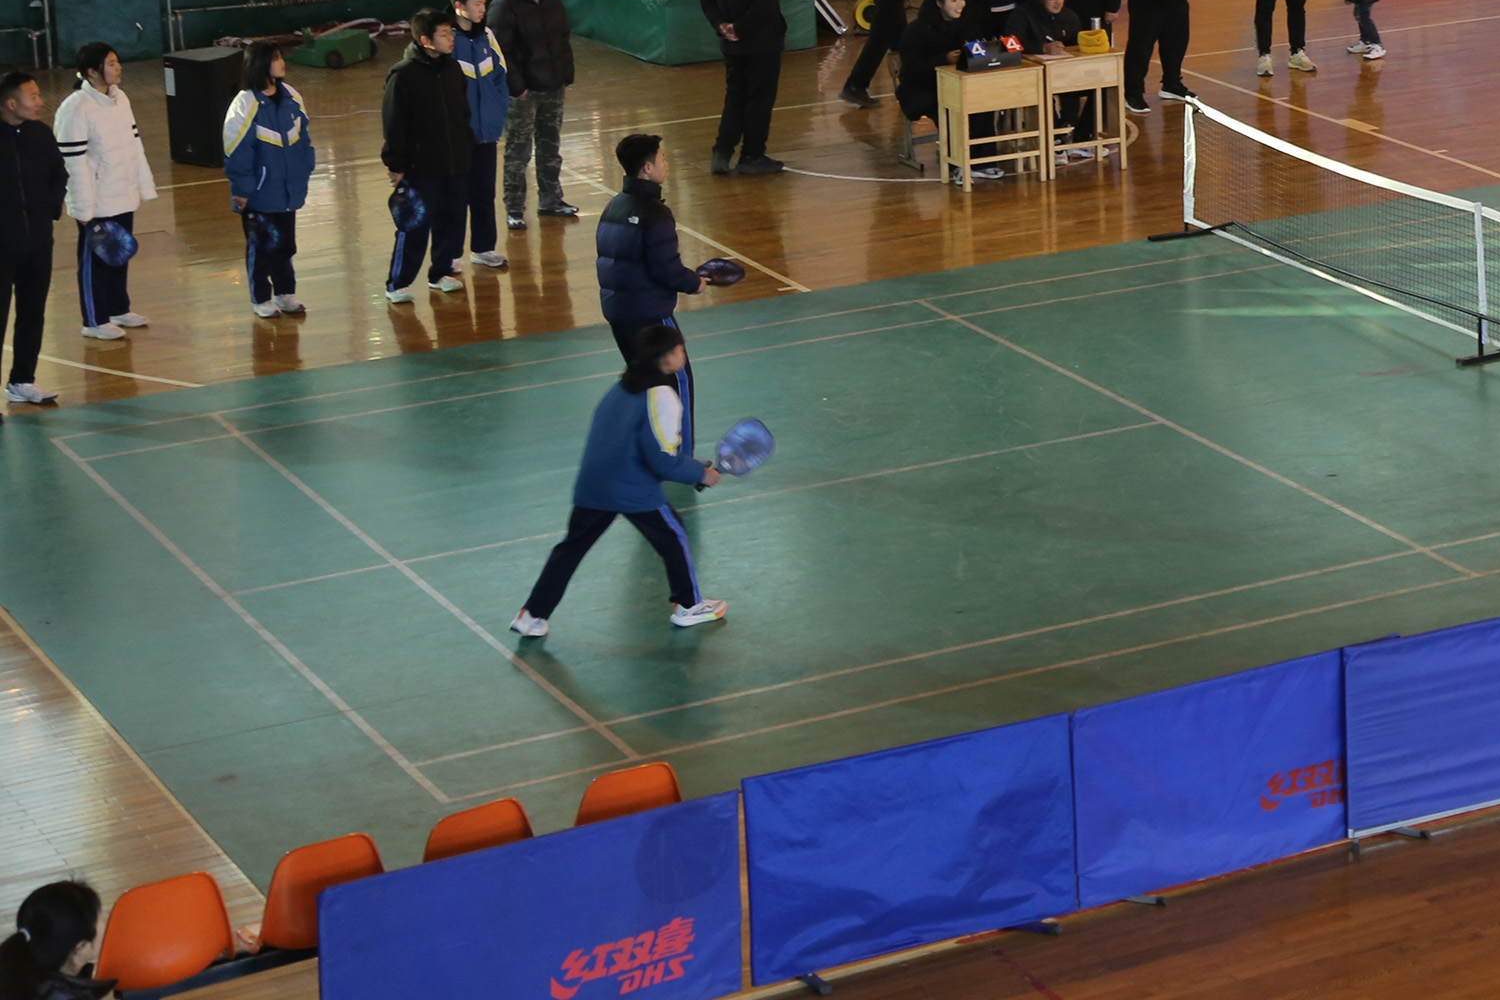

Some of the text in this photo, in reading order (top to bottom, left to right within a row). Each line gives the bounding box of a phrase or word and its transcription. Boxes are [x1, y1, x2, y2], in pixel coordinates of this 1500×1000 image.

[971, 43, 986, 56] 4
[1006, 38, 1021, 51] 4
[1260, 756, 1345, 812] 红双
[1307, 786, 1346, 809] DH
[551, 916, 696, 1000] 红双喜
[617, 954, 694, 995] DHS
